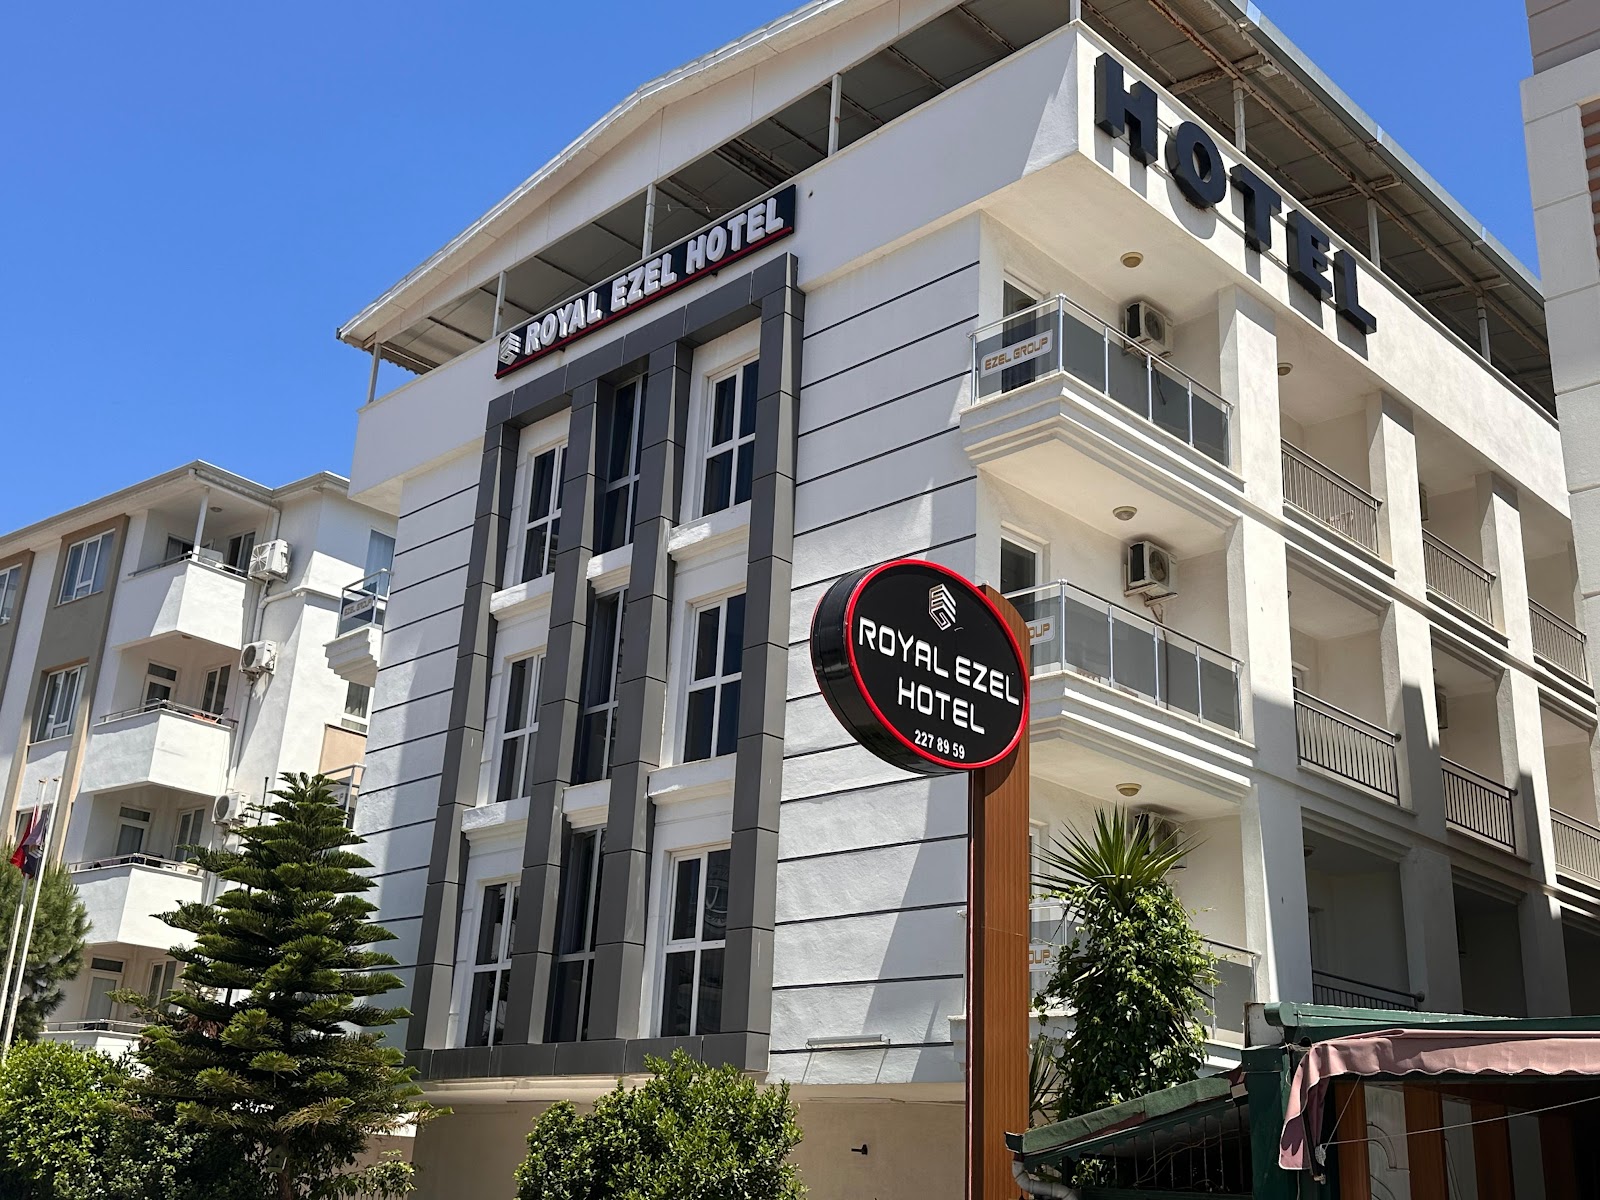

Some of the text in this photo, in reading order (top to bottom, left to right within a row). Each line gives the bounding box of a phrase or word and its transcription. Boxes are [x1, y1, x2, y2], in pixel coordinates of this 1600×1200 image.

[1094, 52, 1377, 335] HOTEL
[524, 197, 784, 356] ROYAL EZEL HOTEL
[984, 336, 1049, 371] EZEL GROUP
[1029, 622, 1050, 639] OUP
[858, 616, 1020, 706] ROYAL EZEL
[898, 676, 985, 734] HOTEL
[914, 729, 966, 760] 227 89 59
[1029, 948, 1051, 964] OUP
